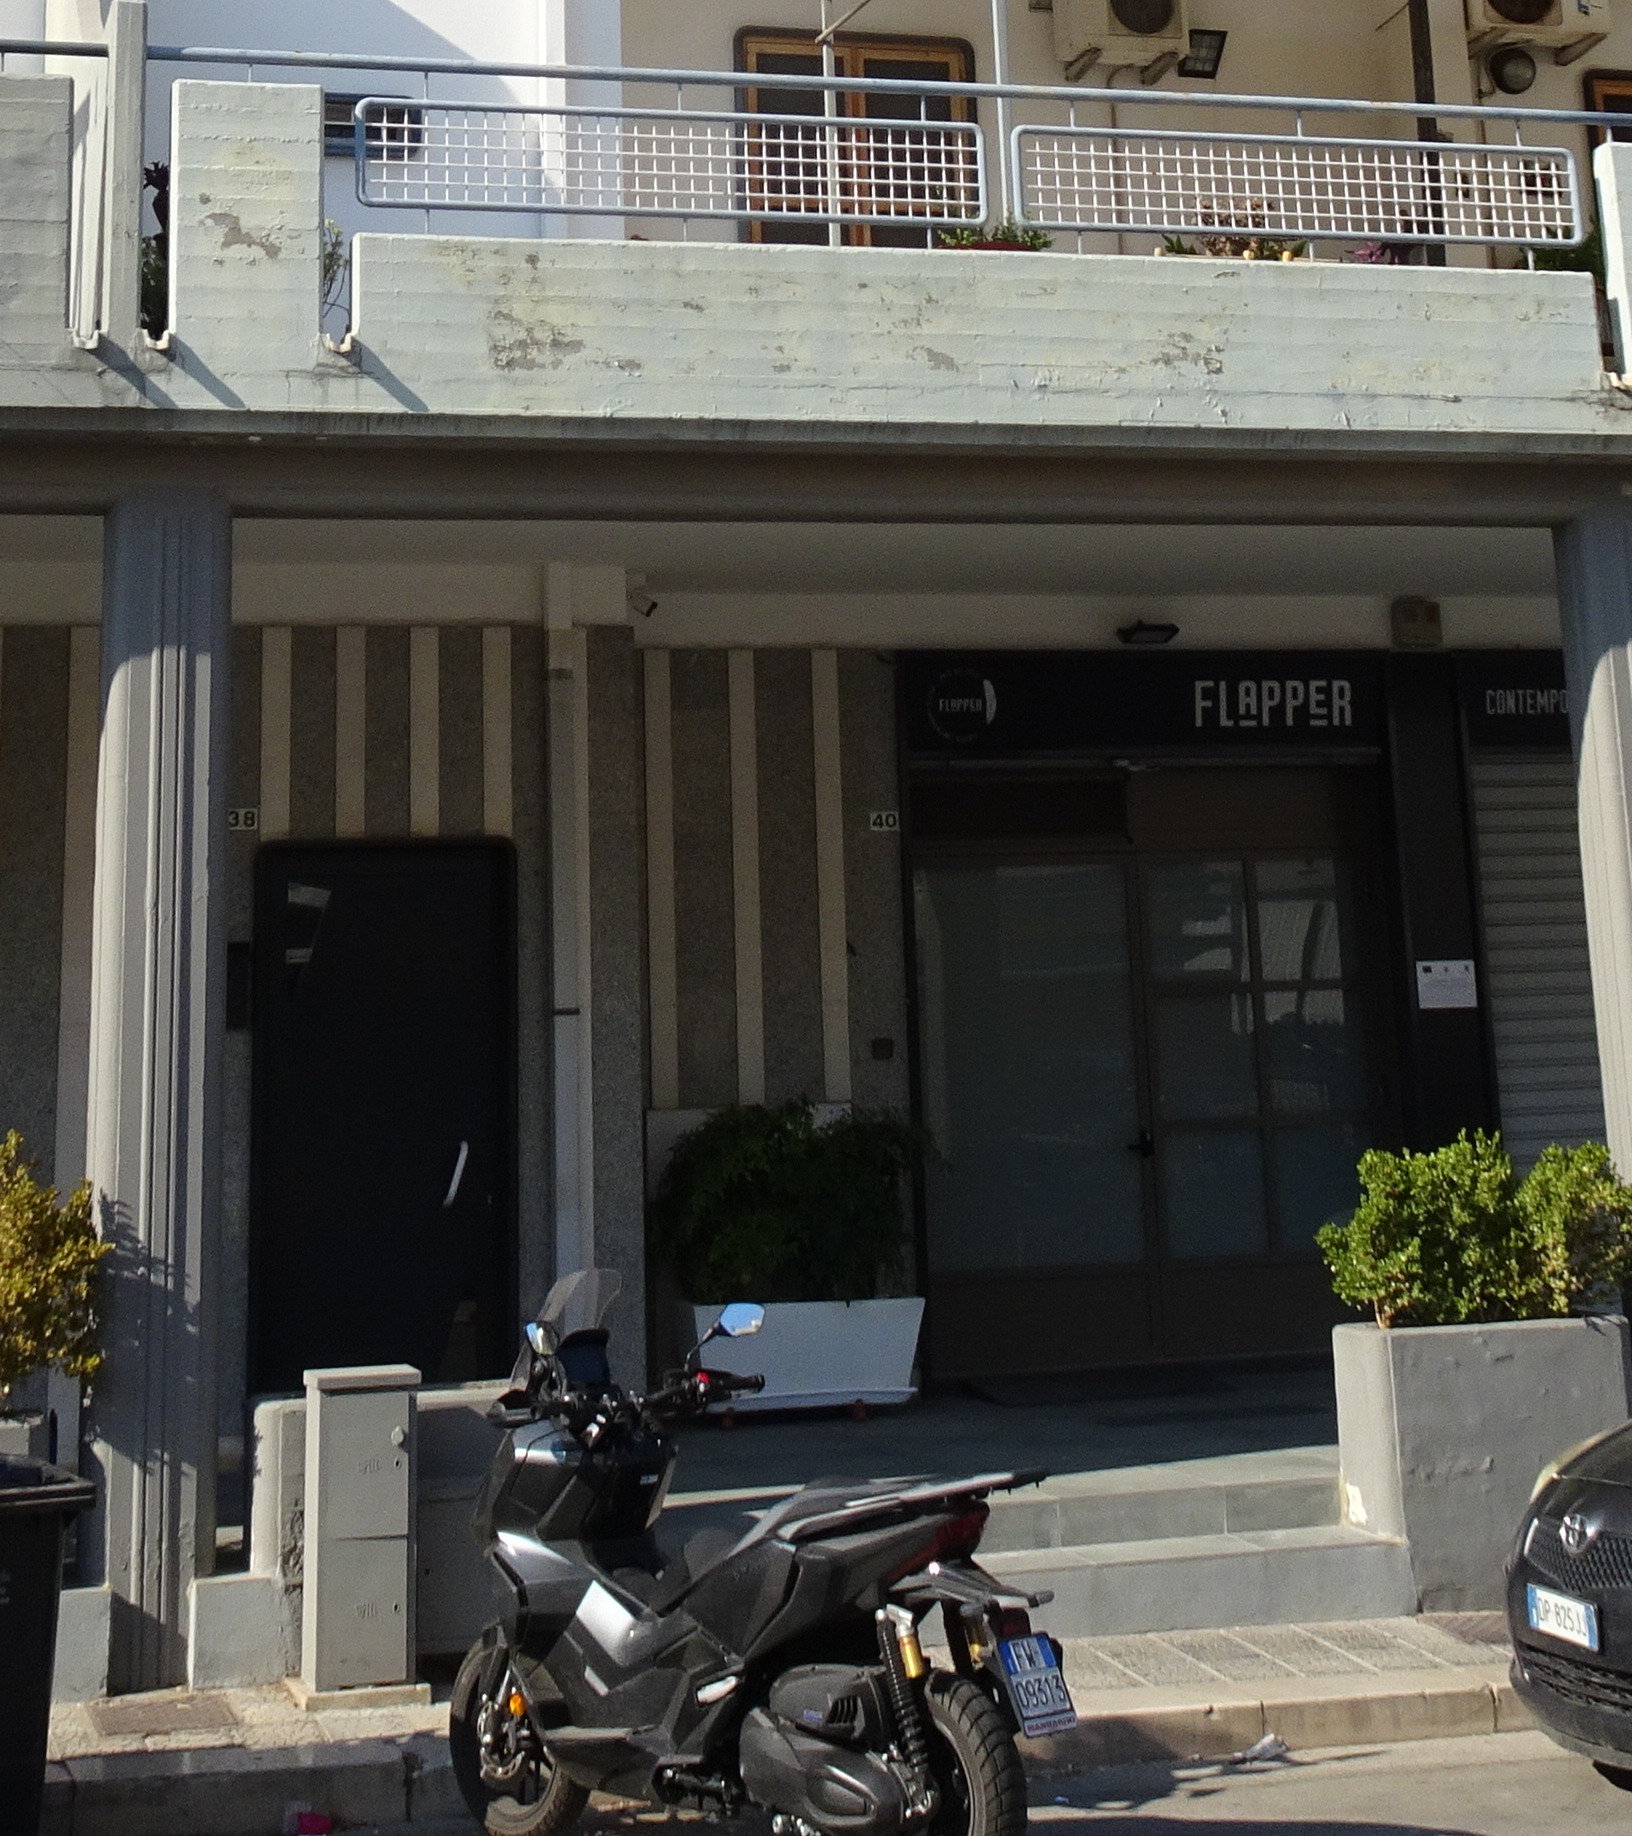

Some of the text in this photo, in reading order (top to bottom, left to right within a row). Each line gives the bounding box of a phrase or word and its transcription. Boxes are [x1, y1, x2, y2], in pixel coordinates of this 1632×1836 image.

[1194, 679, 1353, 727] FLAPPER
[228, 810, 256, 828] 38
[872, 813, 897, 829] 40
[1015, 1674, 1067, 1708] 09313
